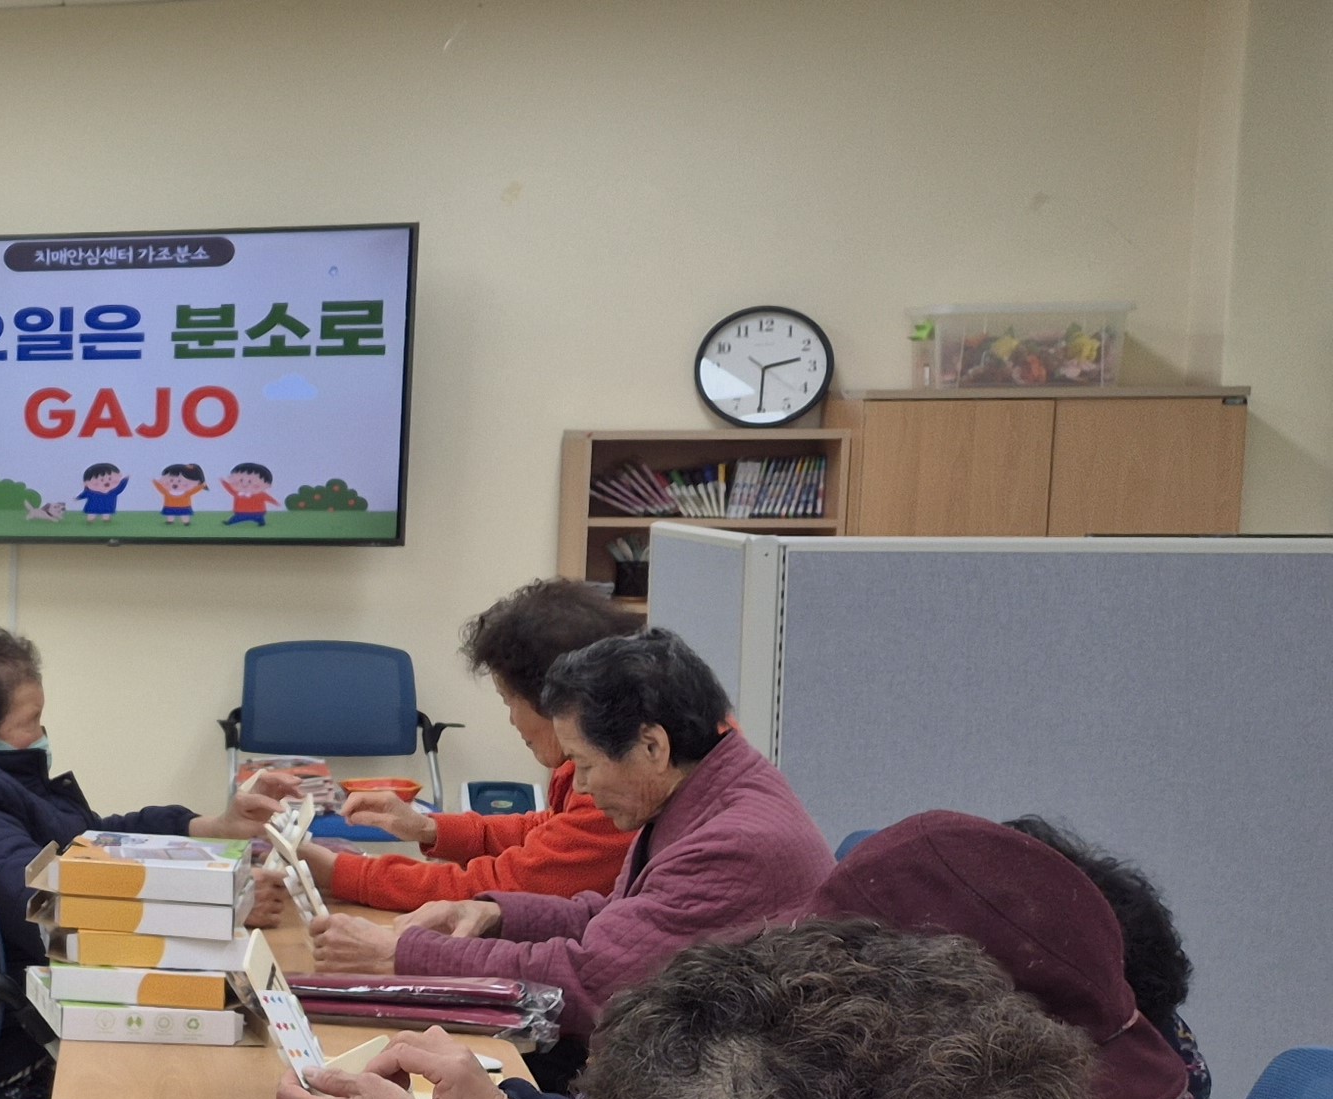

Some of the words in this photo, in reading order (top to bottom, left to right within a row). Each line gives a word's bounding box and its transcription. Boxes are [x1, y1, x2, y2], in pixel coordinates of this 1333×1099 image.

[35, 246, 132, 266] 치매안심센터
[138, 245, 210, 263] 가조분소
[171, 300, 386, 359] 분소로
[735, 325, 749, 338] 11
[758, 318, 774, 332] 12
[786, 324, 793, 338] 1
[717, 341, 731, 354] 10
[801, 338, 811, 351] 2
[808, 360, 817, 373] 3
[23, 385, 240, 439] GAJO
